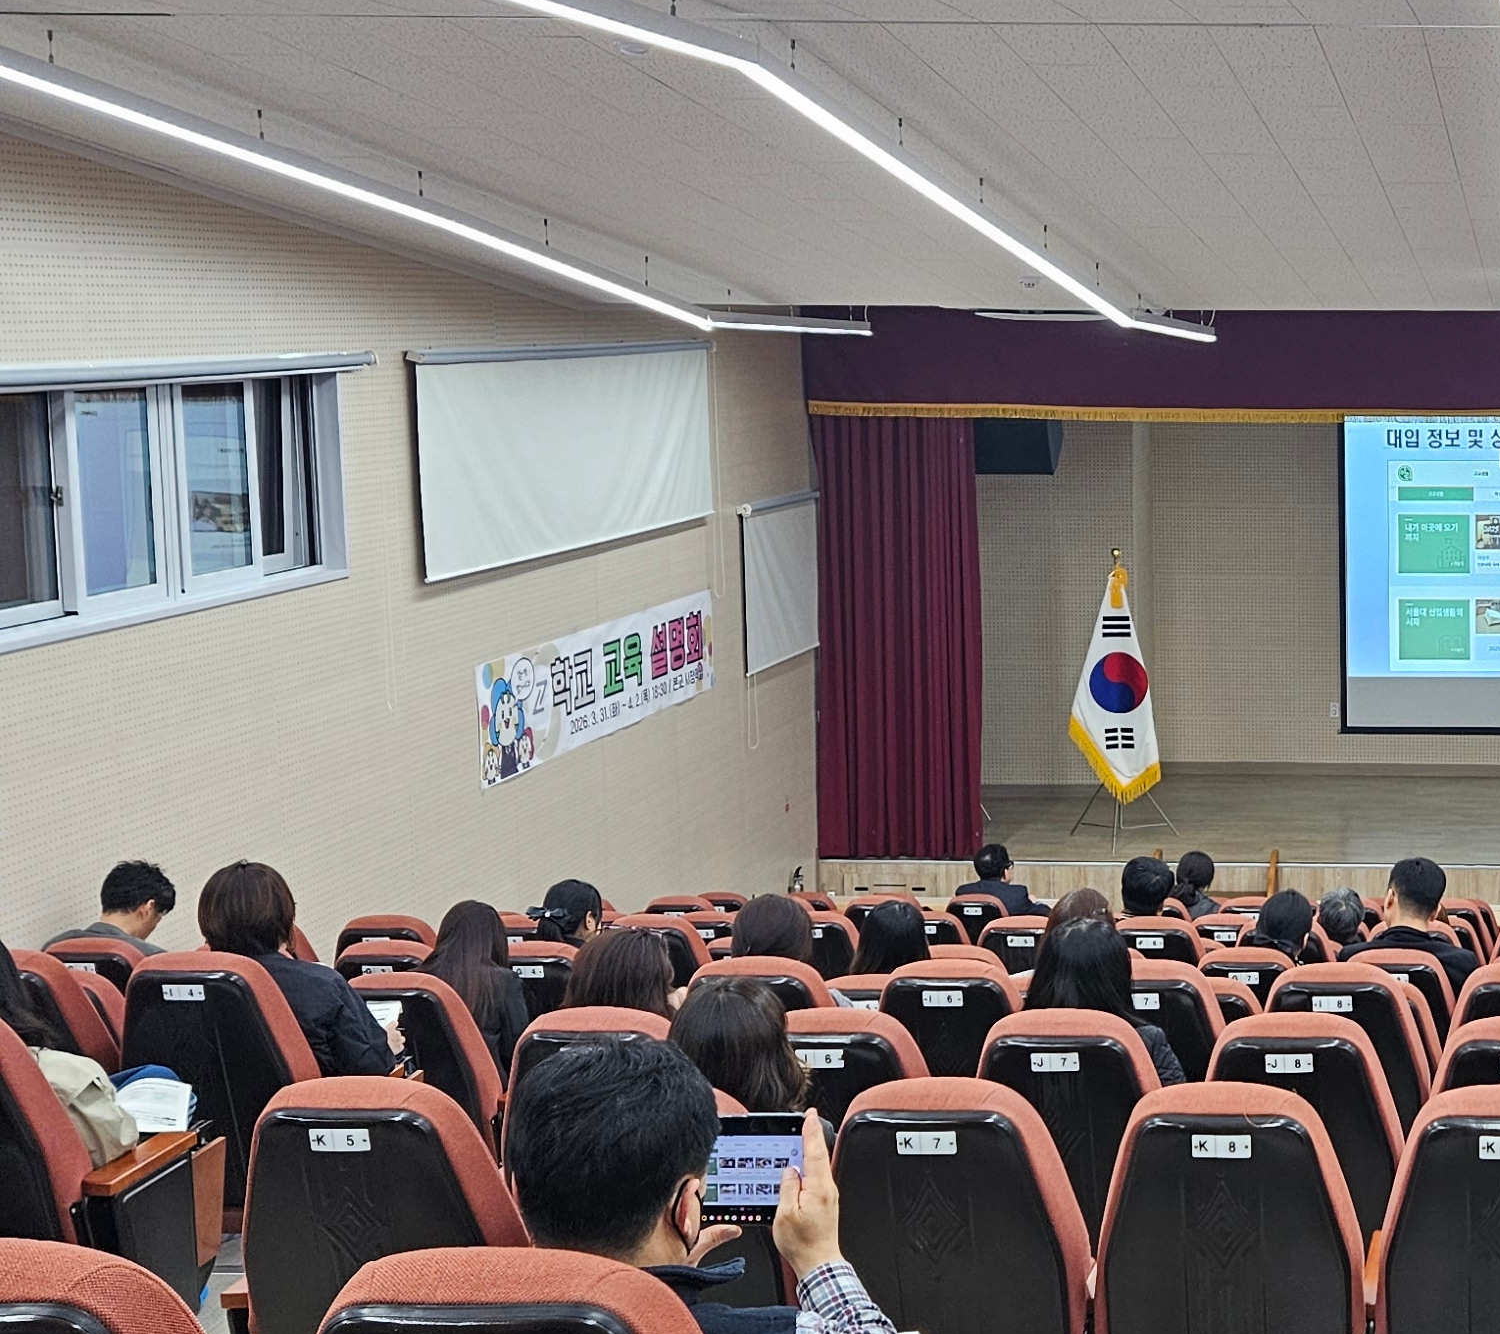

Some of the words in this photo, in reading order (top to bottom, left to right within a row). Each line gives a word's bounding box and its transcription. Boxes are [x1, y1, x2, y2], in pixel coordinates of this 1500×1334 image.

[1386, 428, 1420, 449] 대입
[1427, 428, 1461, 449] 정보
[1467, 428, 1484, 449] 및
[550, 648, 595, 716] 학교
[603, 632, 643, 698] 교육
[650, 610, 703, 680] 설명회
[946, 994, 953, 1004] 6
[1143, 997, 1149, 1006] 7
[1336, 999, 1343, 1009] 8
[824, 1053, 832, 1065] 6
[1036, 1057, 1044, 1068] J
[1060, 1057, 1068, 1067] 7
[1269, 1058, 1278, 1069] J
[1294, 1058, 1302, 1069] 8
[316, 1134, 327, 1146] K
[346, 1134, 355, 1147] 5
[903, 1137, 914, 1149] K
[932, 1137, 941, 1150] 7
[1198, 1140, 1209, 1152] K
[1228, 1141, 1237, 1153] 8
[1486, 1141, 1496, 1154] K
